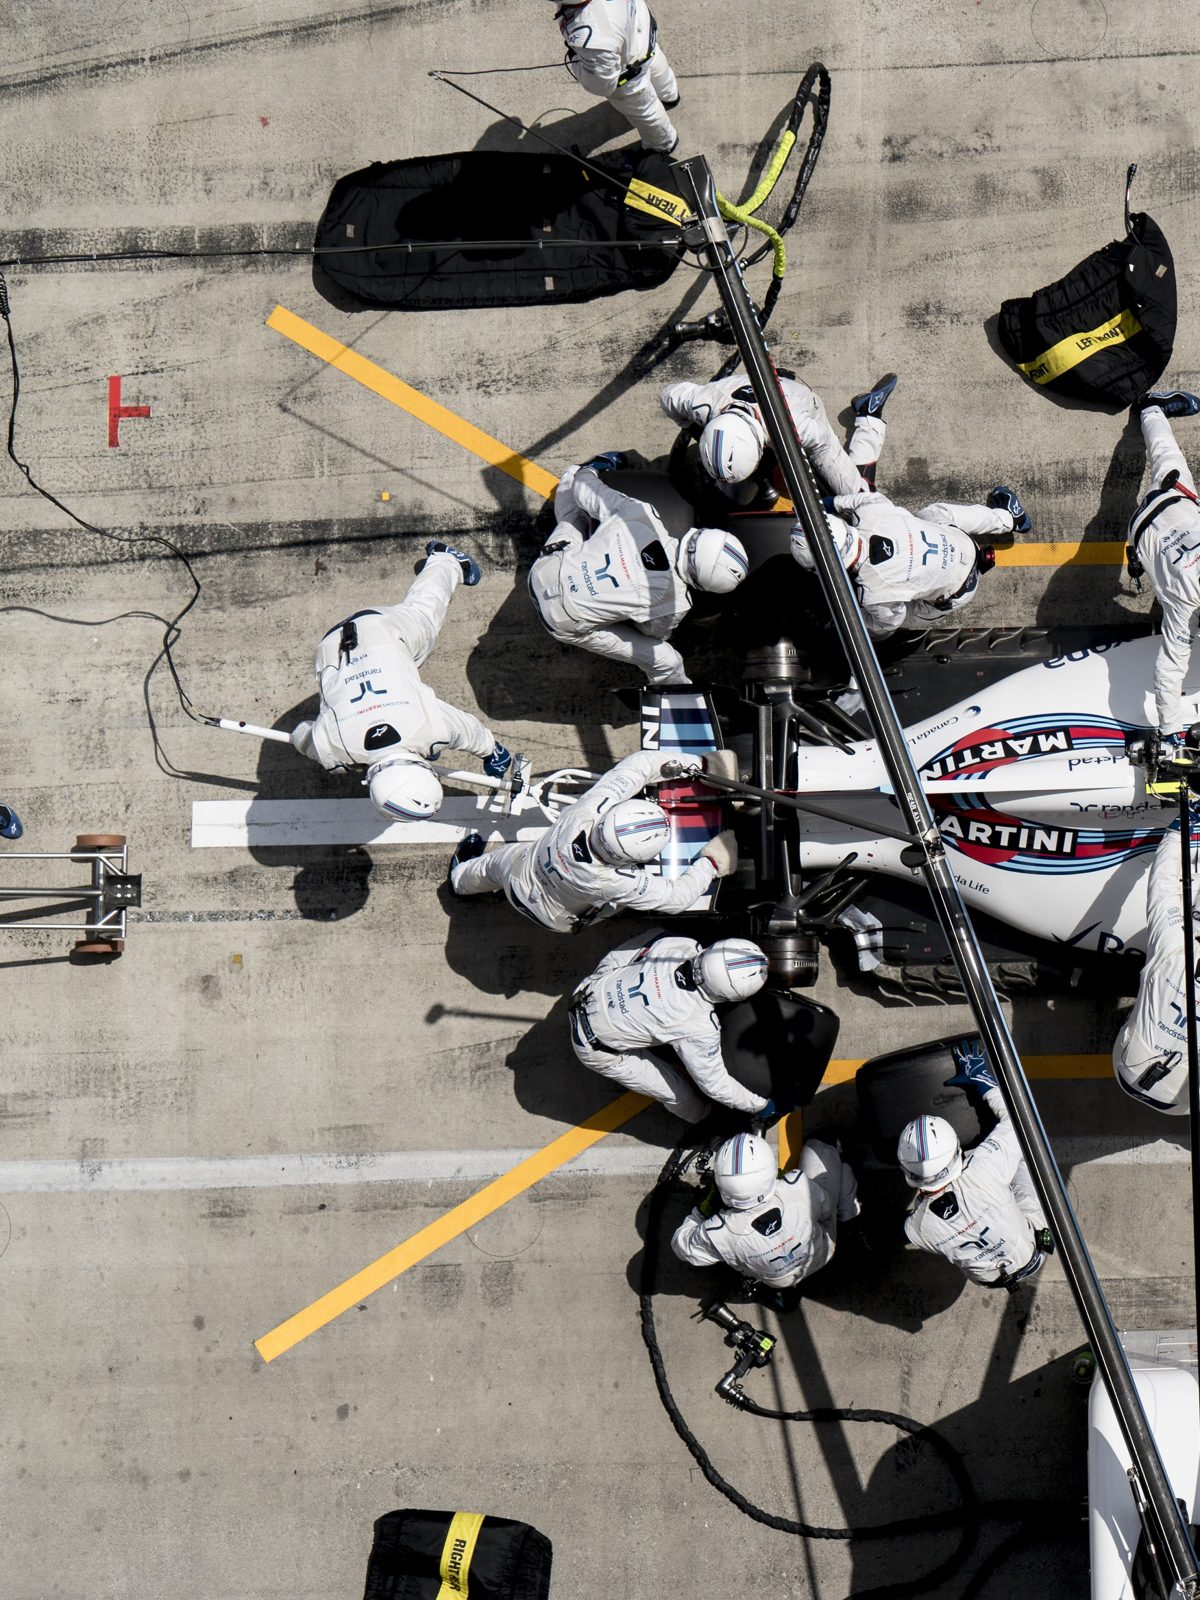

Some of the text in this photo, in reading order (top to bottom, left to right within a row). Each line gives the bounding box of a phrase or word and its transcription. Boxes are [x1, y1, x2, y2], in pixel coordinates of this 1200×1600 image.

[940, 534, 949, 569] randstad
[1160, 529, 1190, 555] randstad
[581, 560, 597, 596] randstad
[344, 666, 381, 683] randstad
[918, 715, 959, 740] Canada
[919, 731, 1068, 780] MARTIN
[940, 815, 1074, 853] ARTINI
[967, 879, 990, 894] Life
[616, 980, 629, 1014] randstad
[973, 1236, 1005, 1262] randstad
[448, 1538, 466, 1576] RIGHT
